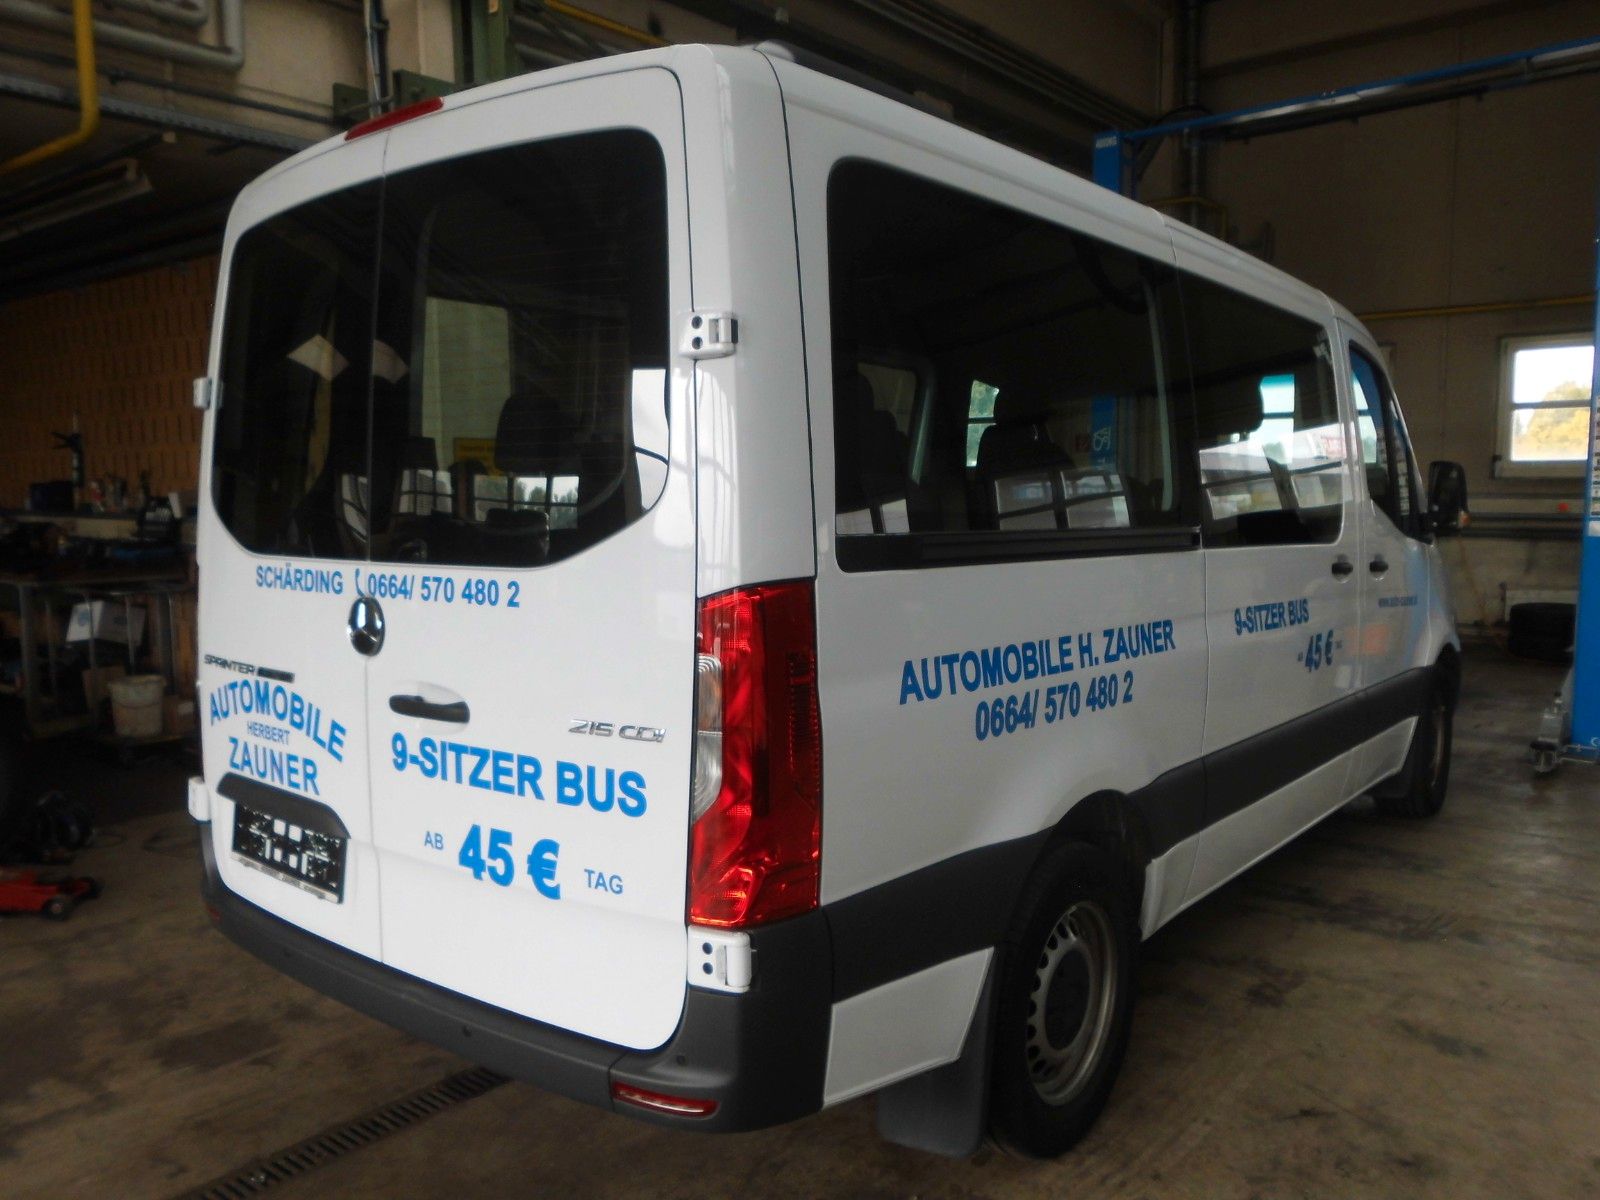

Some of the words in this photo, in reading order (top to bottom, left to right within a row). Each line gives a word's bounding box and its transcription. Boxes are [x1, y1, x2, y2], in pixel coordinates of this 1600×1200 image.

[256, 563, 343, 595] SCHÄRDING
[368, 573, 415, 600] 0664/
[421, 576, 455, 602] 570
[462, 578, 499, 606] 480
[507, 580, 520, 608] 2
[1234, 602, 1286, 636] 9-SITZER
[1288, 598, 1310, 626] BUS
[204, 654, 255, 675] SPRINTER
[900, 635, 1074, 705] AUTOMOBILE
[1078, 633, 1099, 668] H.
[1103, 619, 1176, 663] ZAUNER
[1305, 633, 1322, 672] 45
[209, 679, 346, 762] AUTOMOBILE
[568, 719, 614, 737] 215
[619, 725, 666, 743] CDI
[976, 688, 1039, 741] 0664/
[1045, 682, 1080, 724] 570
[1086, 672, 1118, 712] 480
[1124, 670, 1133, 703] 2
[246, 722, 290, 746] HERBERT
[228, 736, 320, 796] ZAUNER
[392, 732, 545, 800] 9-SITZER
[556, 760, 648, 817] BUS
[424, 831, 444, 850] AB
[458, 824, 514, 887] 45
[527, 839, 561, 900] €
[584, 868, 624, 895] TAG
